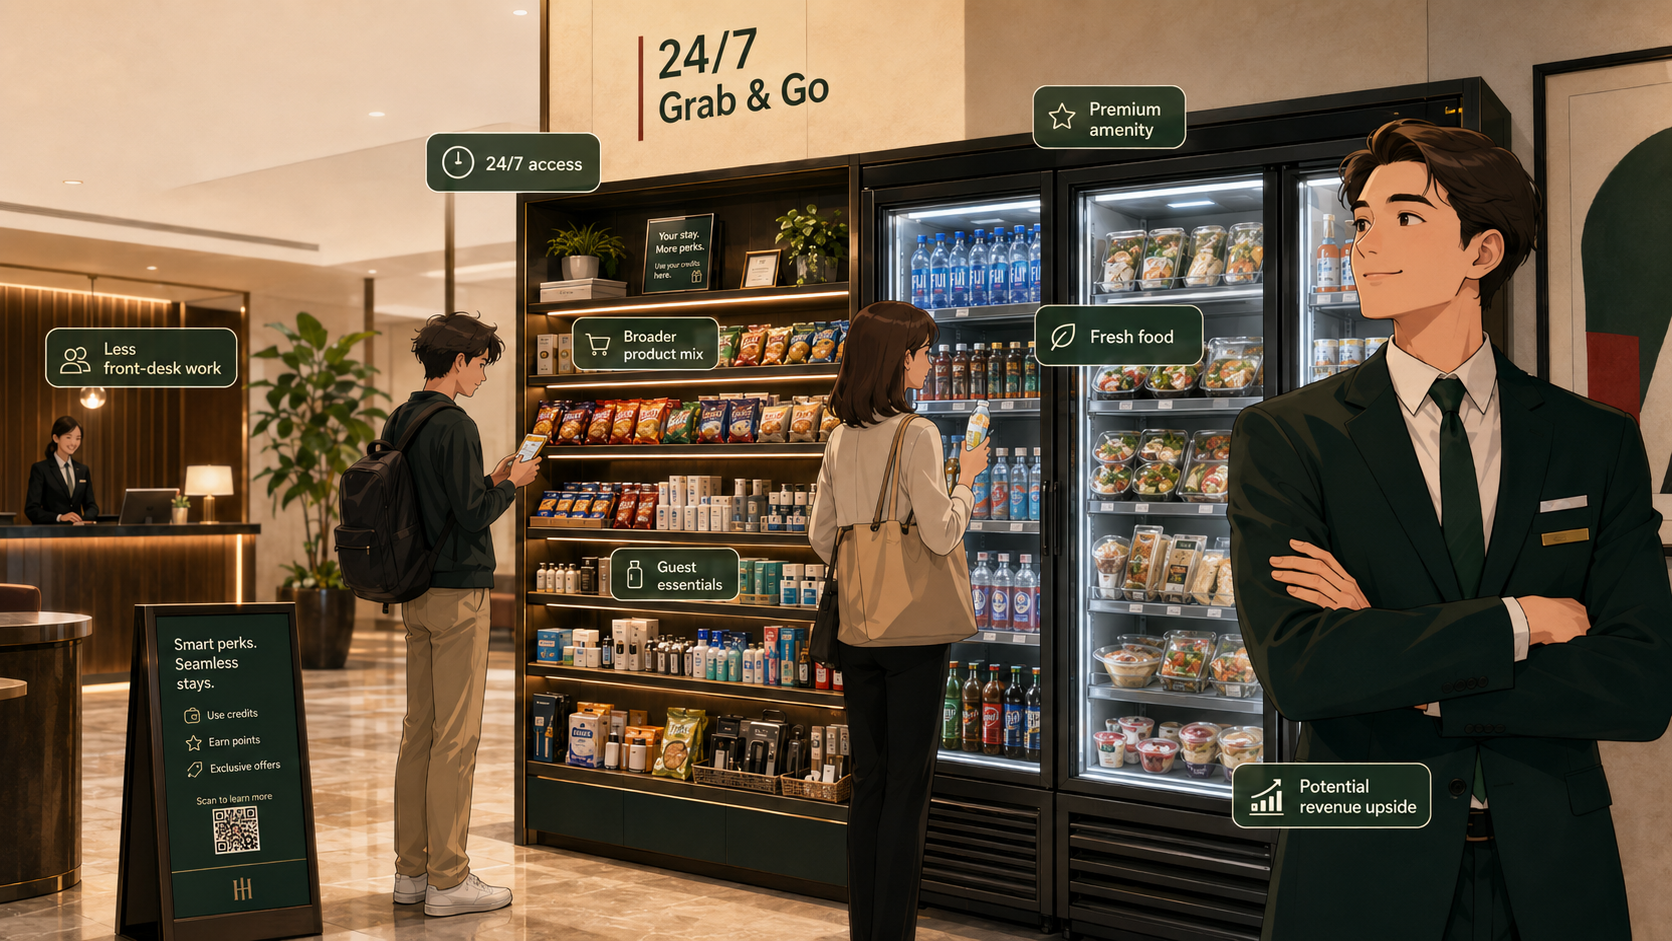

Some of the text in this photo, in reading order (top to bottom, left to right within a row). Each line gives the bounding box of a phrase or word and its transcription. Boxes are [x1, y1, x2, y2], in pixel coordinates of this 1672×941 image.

[659, 27, 757, 80] 24/7
[659, 72, 829, 123] Grab & Go
[658, 230, 699, 240] Your stay.
[655, 242, 704, 254] More perks.
[653, 271, 671, 279] here.
[174, 636, 256, 652] Smart perks.
[175, 655, 238, 670] Seamless
[176, 677, 214, 692] stays.
[207, 708, 258, 719] Use credits
[208, 735, 260, 747] Earn points
[210, 759, 280, 773] Exclusive offers
[196, 796, 217, 806] Scan
[229, 793, 250, 804] learn
[252, 791, 273, 802] more
